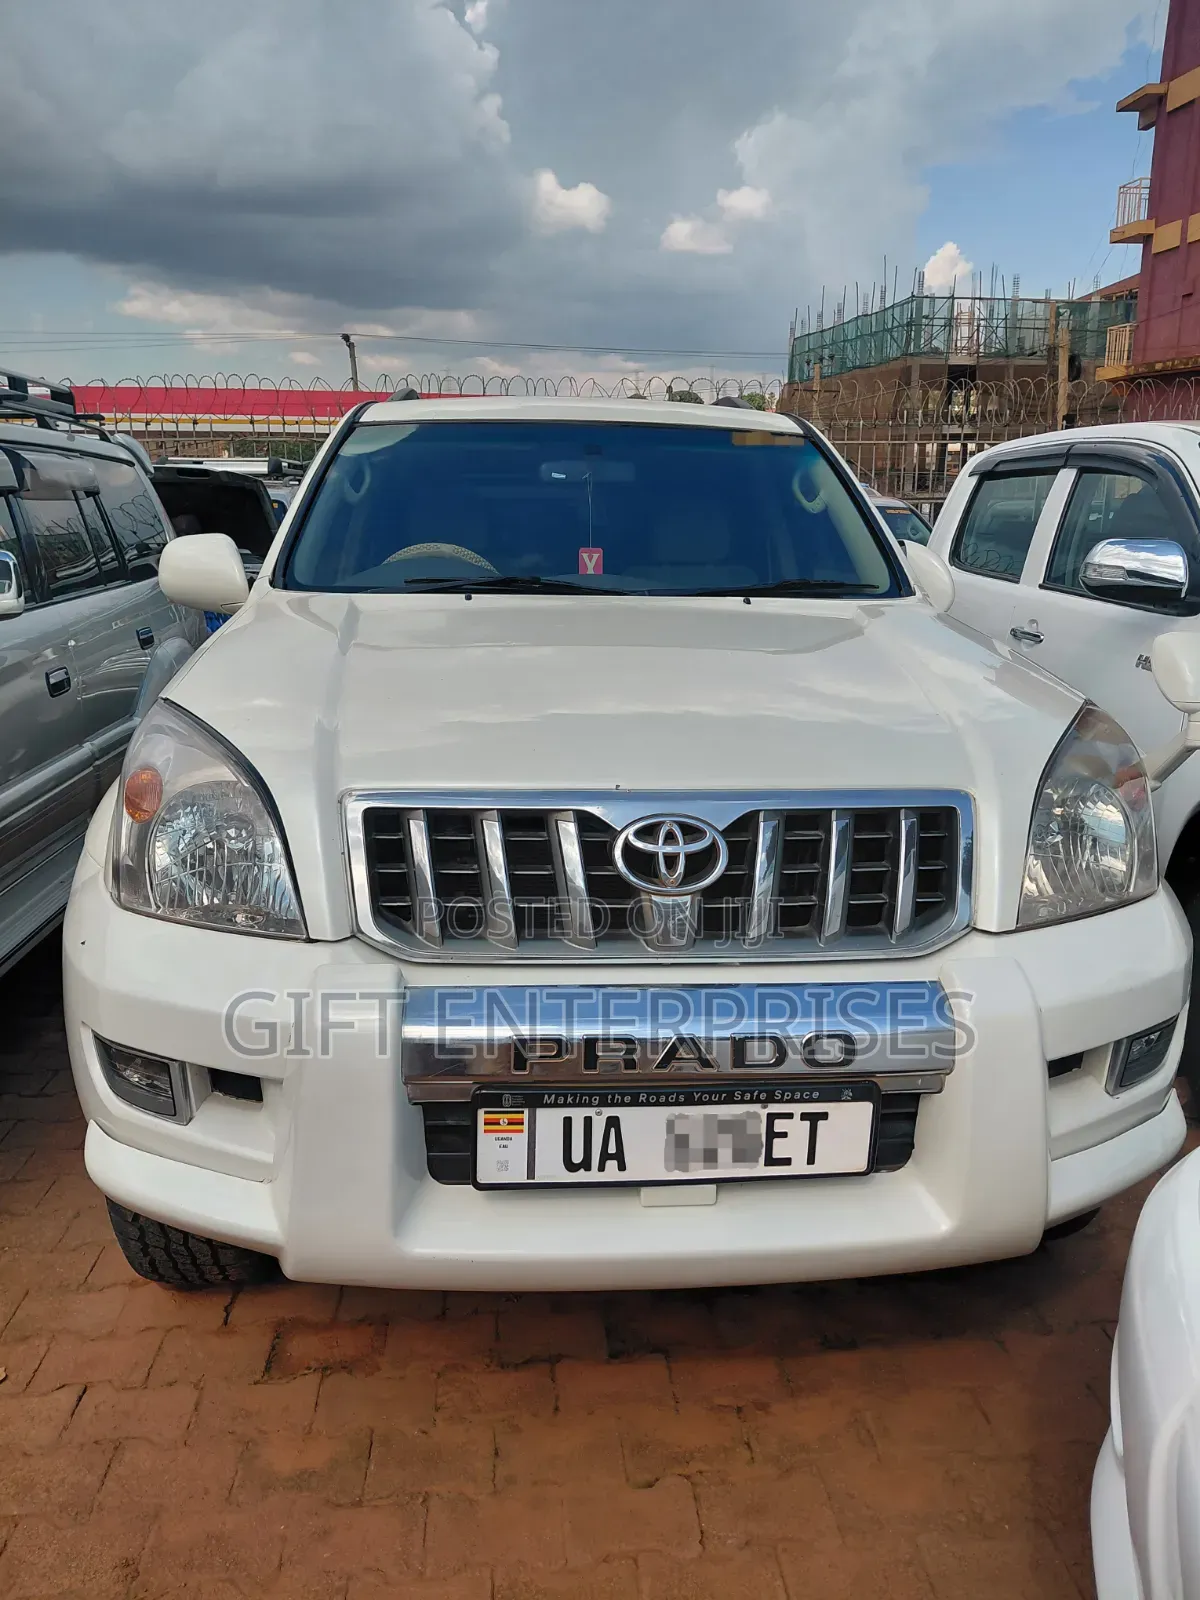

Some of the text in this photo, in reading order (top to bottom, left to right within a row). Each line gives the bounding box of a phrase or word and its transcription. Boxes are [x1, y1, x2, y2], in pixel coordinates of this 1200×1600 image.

[581, 552, 600, 574] Y
[511, 1030, 858, 1075] PRADO
[543, 1089, 820, 1106] Making the Roads Your Safe Space
[562, 1115, 627, 1173] UA
[764, 1111, 829, 1167] ET
